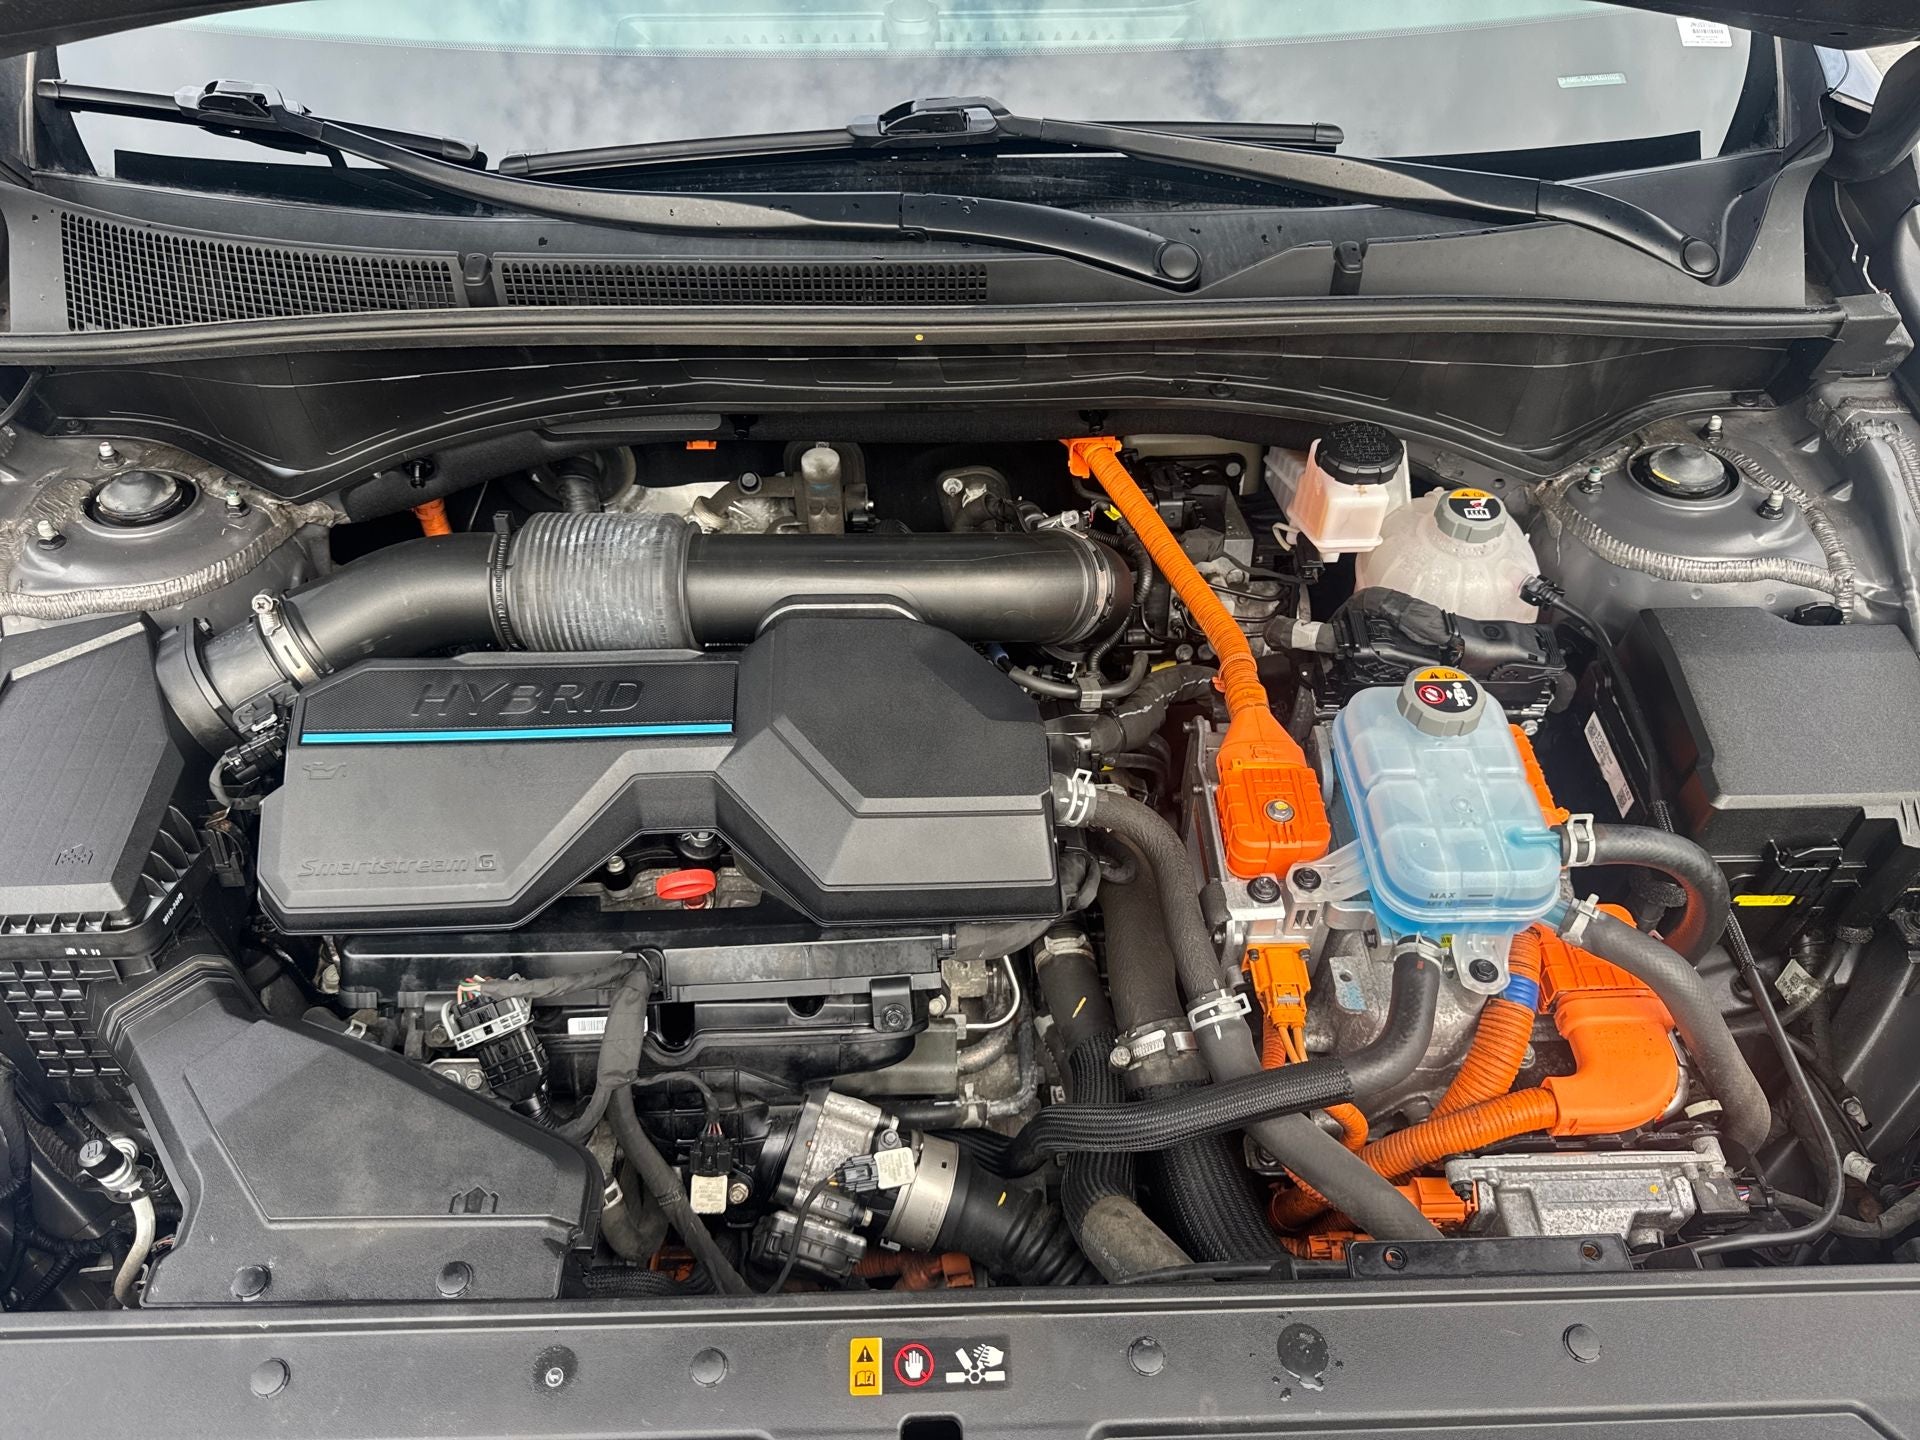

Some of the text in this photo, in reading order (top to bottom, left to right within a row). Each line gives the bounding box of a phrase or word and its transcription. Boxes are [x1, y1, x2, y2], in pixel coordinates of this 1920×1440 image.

[411, 680, 644, 716] HYBRID
[297, 854, 496, 876] Smartstream G
